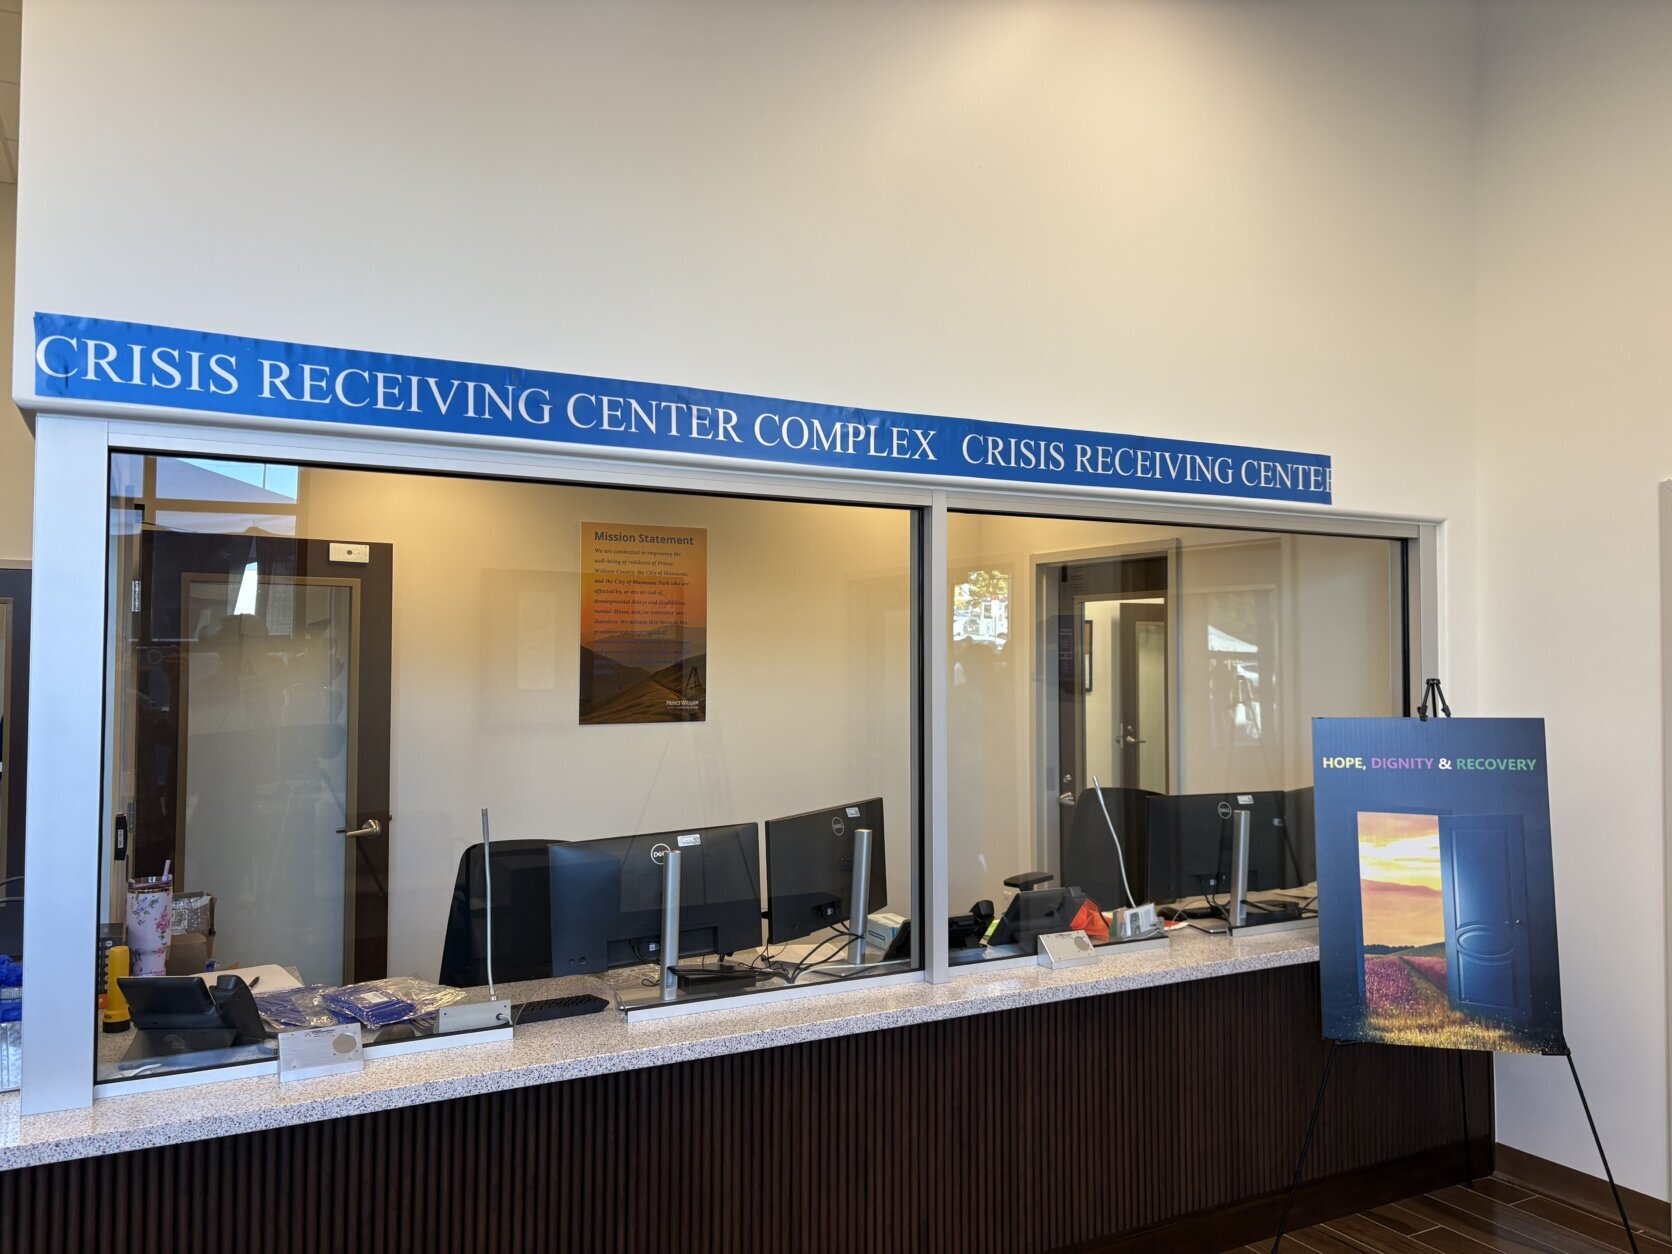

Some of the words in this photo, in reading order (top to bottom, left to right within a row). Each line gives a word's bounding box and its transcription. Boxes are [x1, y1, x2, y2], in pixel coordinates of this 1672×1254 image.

[36, 335, 239, 395] CRISIS
[257, 359, 552, 424] RECEIVING
[567, 392, 743, 443] CENTER
[753, 413, 938, 461] COMPLEX
[962, 433, 1065, 472] CRISIS
[1074, 444, 1233, 485] RECEIVING
[594, 531, 636, 543] Mission
[638, 534, 695, 545] Statement
[1322, 757, 1366, 770] HOPE,
[1371, 757, 1433, 769] DIGNITY
[1438, 757, 1452, 770] &
[1457, 758, 1536, 771] RECOVERY
